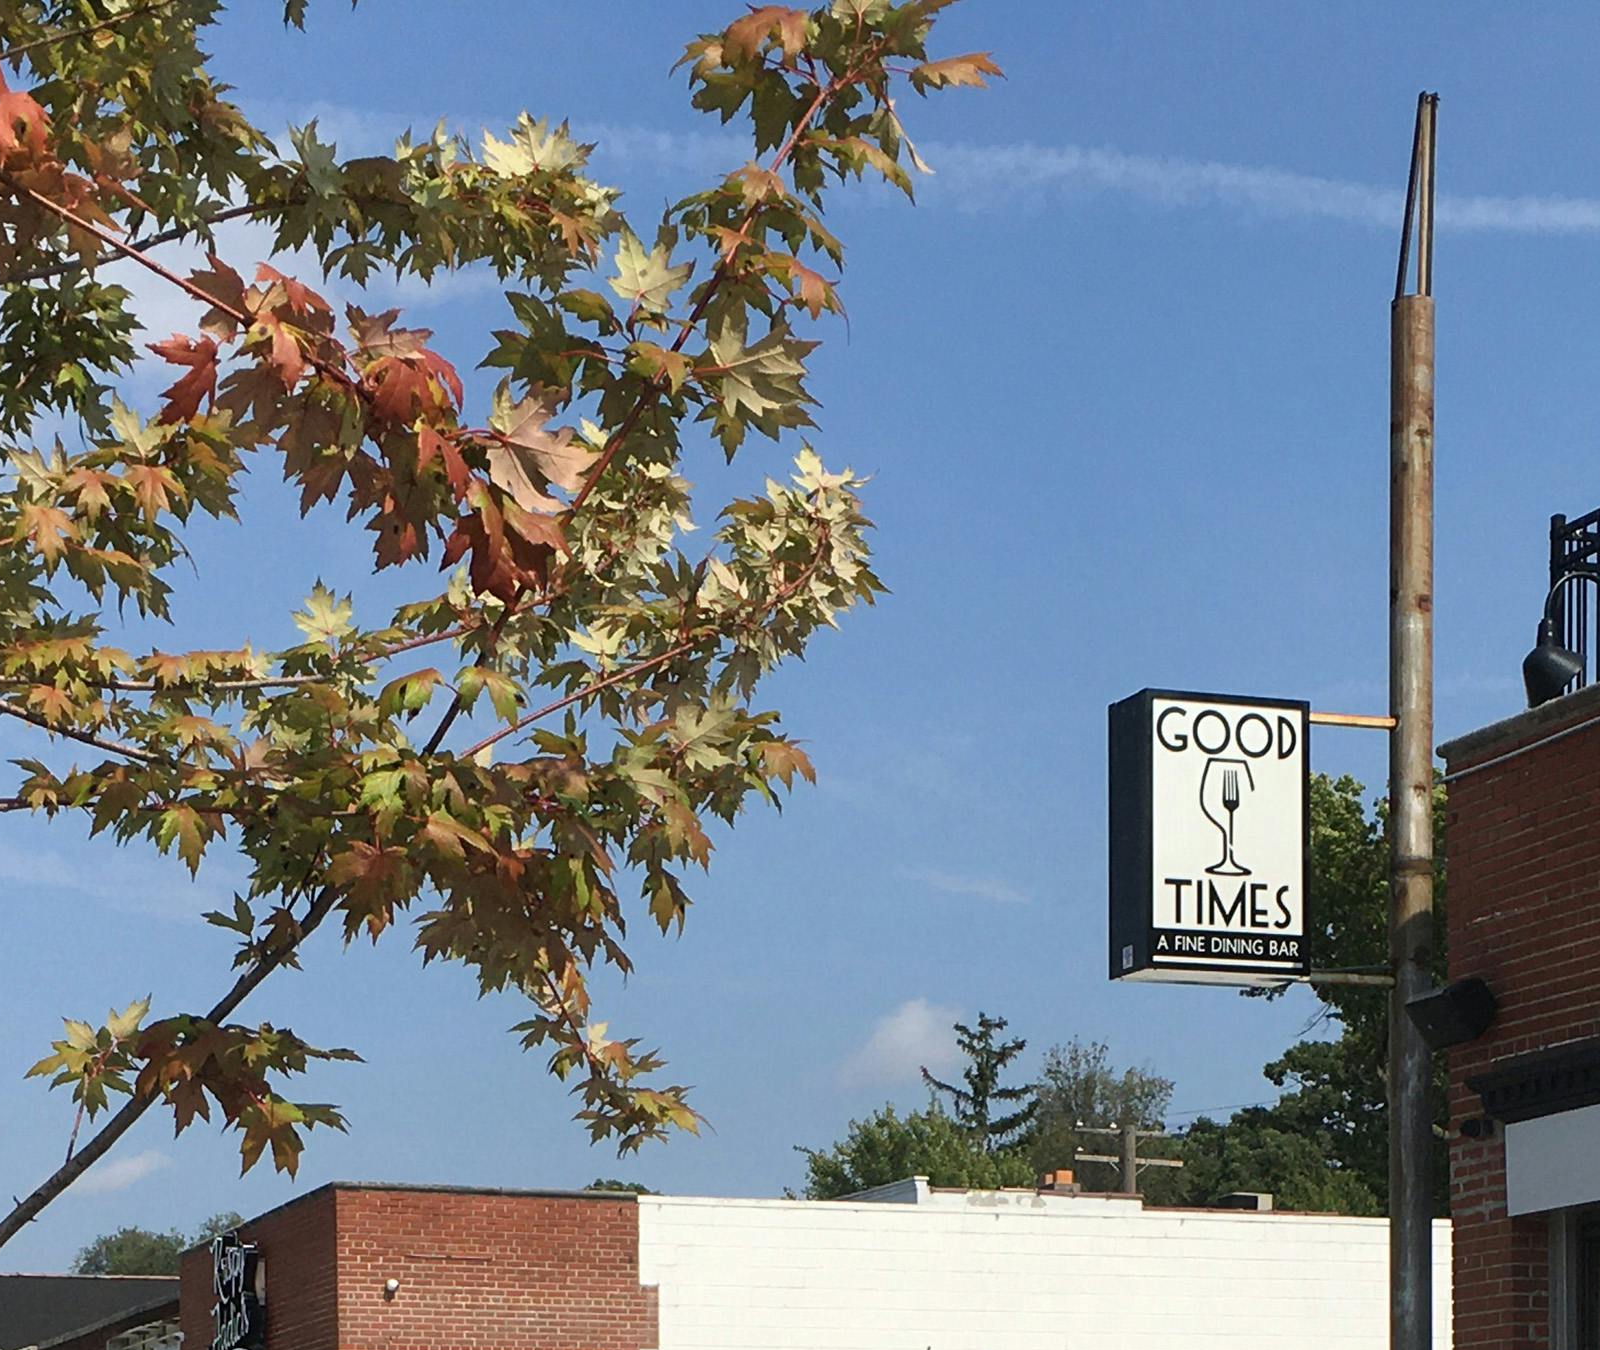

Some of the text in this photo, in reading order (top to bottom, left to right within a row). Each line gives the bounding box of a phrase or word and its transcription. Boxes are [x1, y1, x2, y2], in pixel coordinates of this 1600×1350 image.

[1156, 706, 1296, 759] GOOD
[1164, 878, 1292, 929] TIMES
[1157, 935, 1299, 957] A FINE DINING BAR
